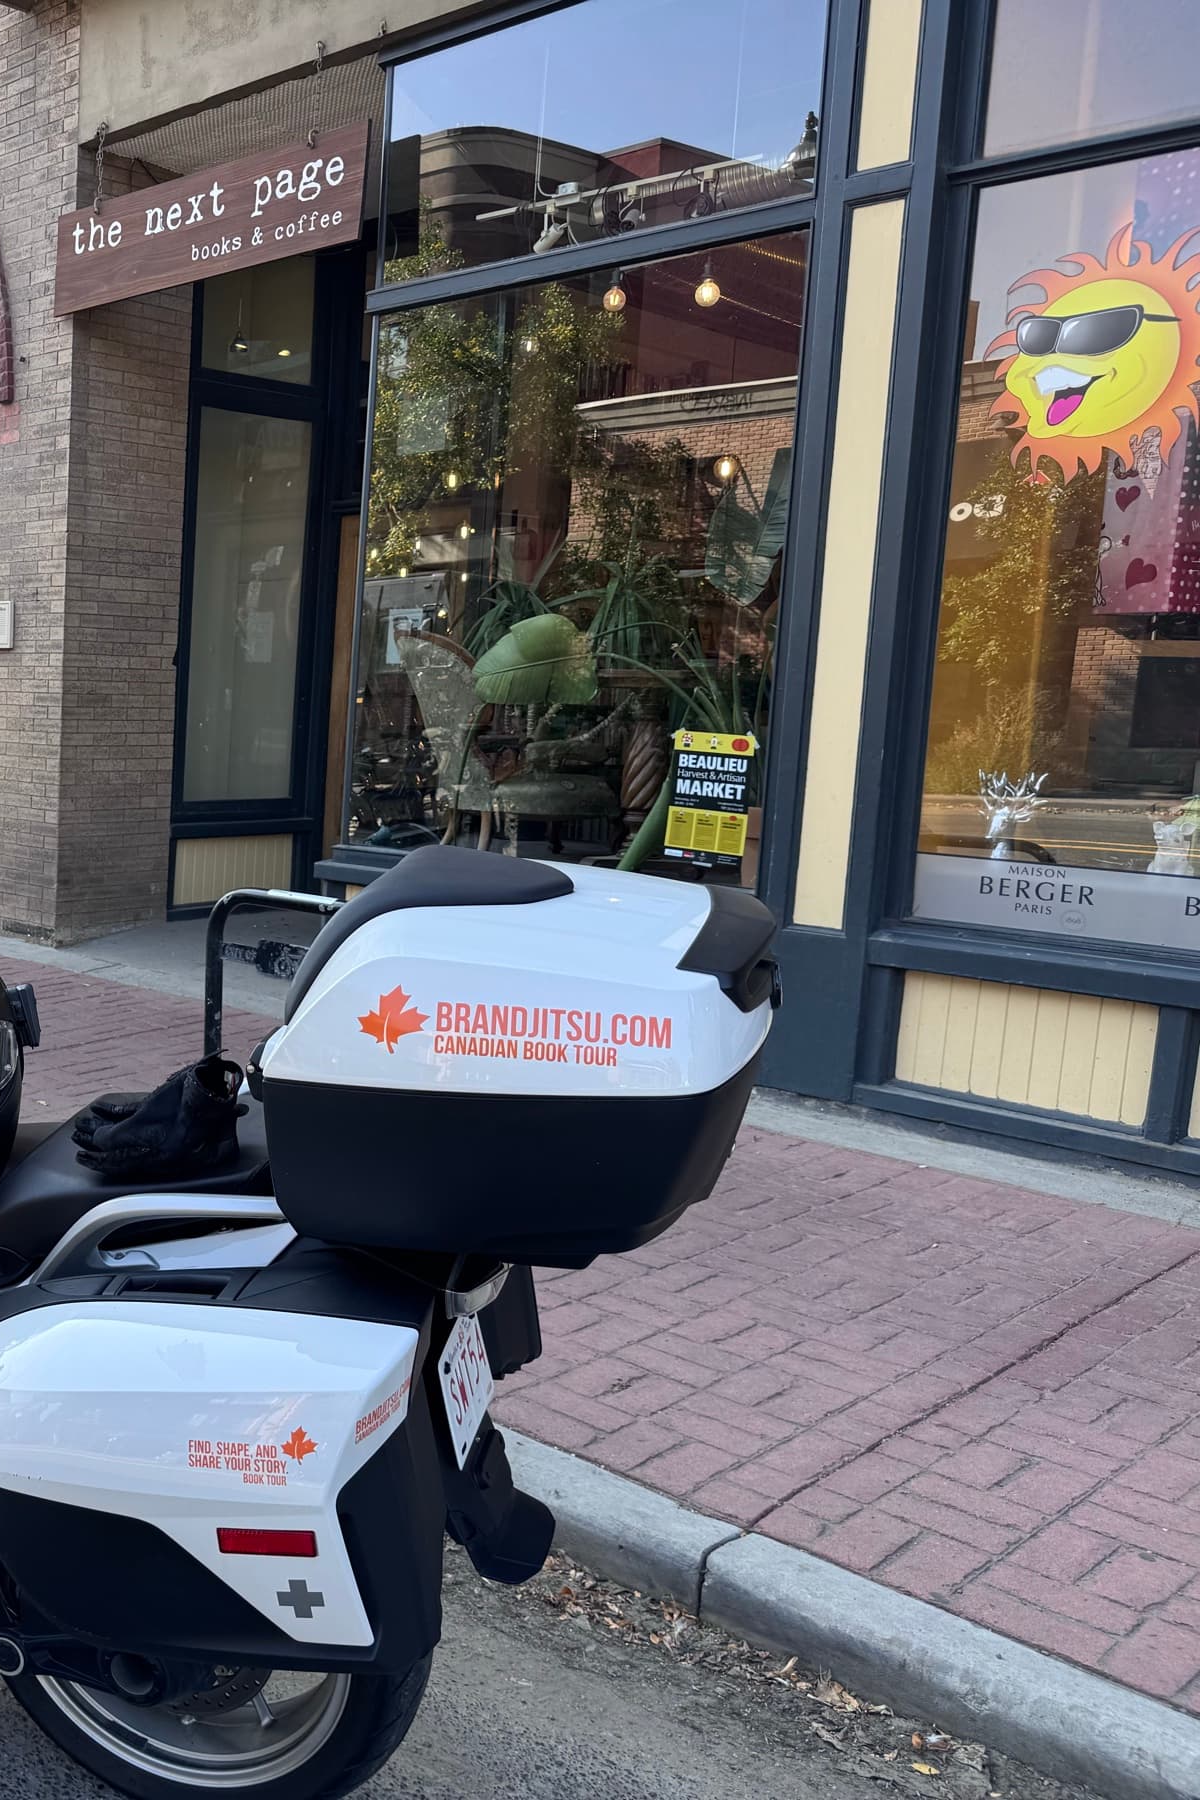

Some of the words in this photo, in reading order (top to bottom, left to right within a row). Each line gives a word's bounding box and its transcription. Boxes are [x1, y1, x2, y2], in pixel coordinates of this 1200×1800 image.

[72, 217, 122, 255] the
[144, 181, 225, 237] next
[250, 155, 345, 219] page
[191, 236, 242, 262] books
[251, 226, 264, 247] &
[274, 209, 343, 241] coffee
[678, 753, 748, 773] BEAULIEU
[677, 767, 708, 779] Harvest
[708, 771, 717, 780] &
[717, 772, 746, 783] Artisan
[676, 778, 746, 800] MARKET
[1007, 865, 1066, 879] MAISON
[979, 876, 1095, 906] BERGER
[1014, 903, 1053, 915] PARIS
[436, 1001, 672, 1049] BRANDJITSU.COM
[433, 1034, 518, 1059] CANADIAN
[523, 1041, 568, 1063] BOOK
[573, 1044, 617, 1067] TOUR
[188, 1439, 214, 1455] FIND,
[216, 1441, 253, 1458] SHAPE,
[255, 1444, 277, 1459] AND
[188, 1454, 222, 1469] SHARE
[224, 1456, 251, 1472] YOUR
[254, 1459, 289, 1475] STORY.
[243, 1472, 264, 1485] BOOK
[266, 1474, 287, 1487] TOUR
